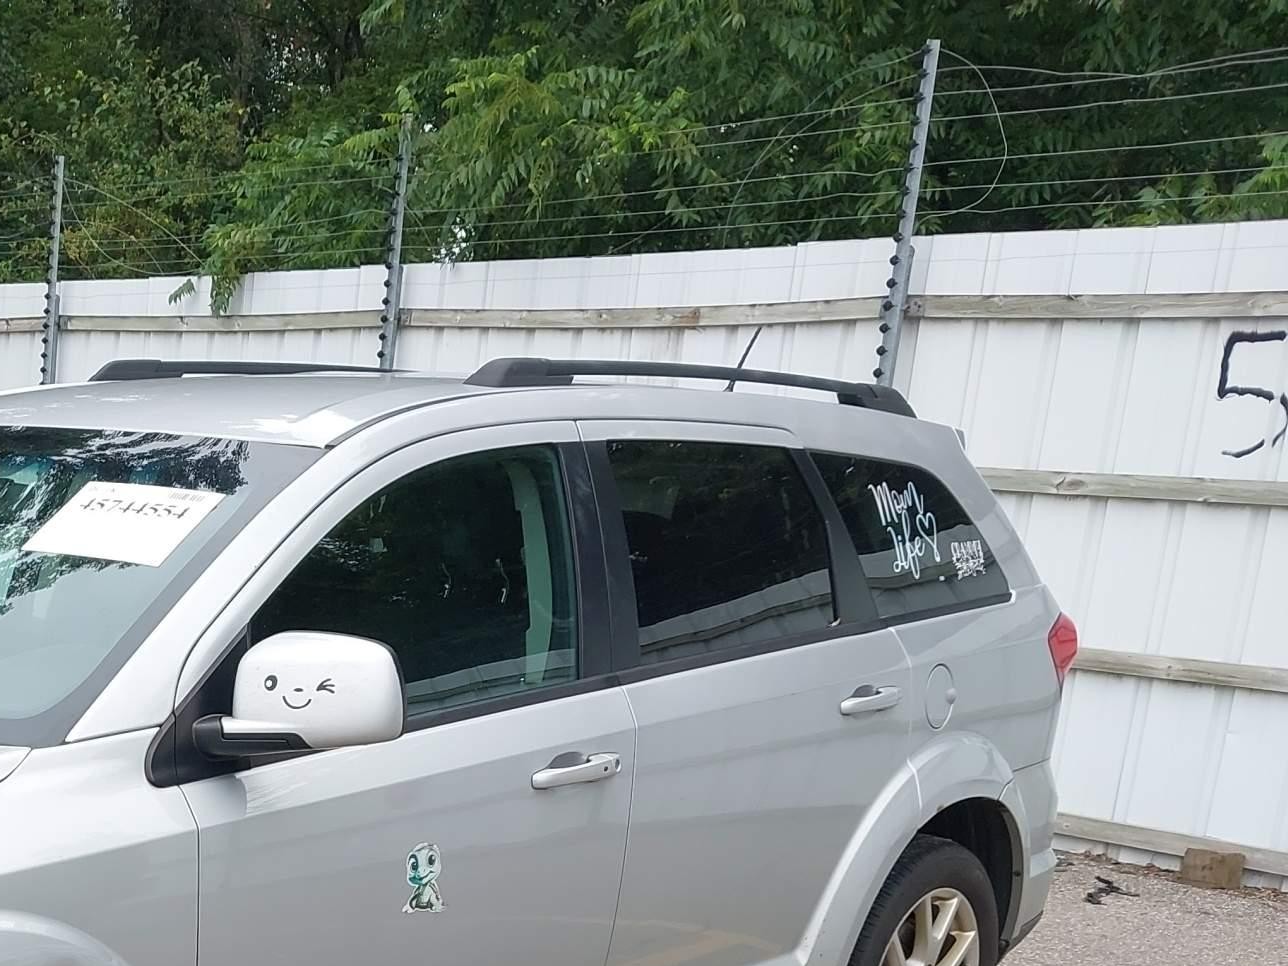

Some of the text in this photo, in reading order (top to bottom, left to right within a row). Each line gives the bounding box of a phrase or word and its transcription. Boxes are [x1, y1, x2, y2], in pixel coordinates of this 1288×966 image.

[79, 497, 191, 520] 45744554
[867, 481, 924, 526] Mom
[886, 509, 926, 580] Life
